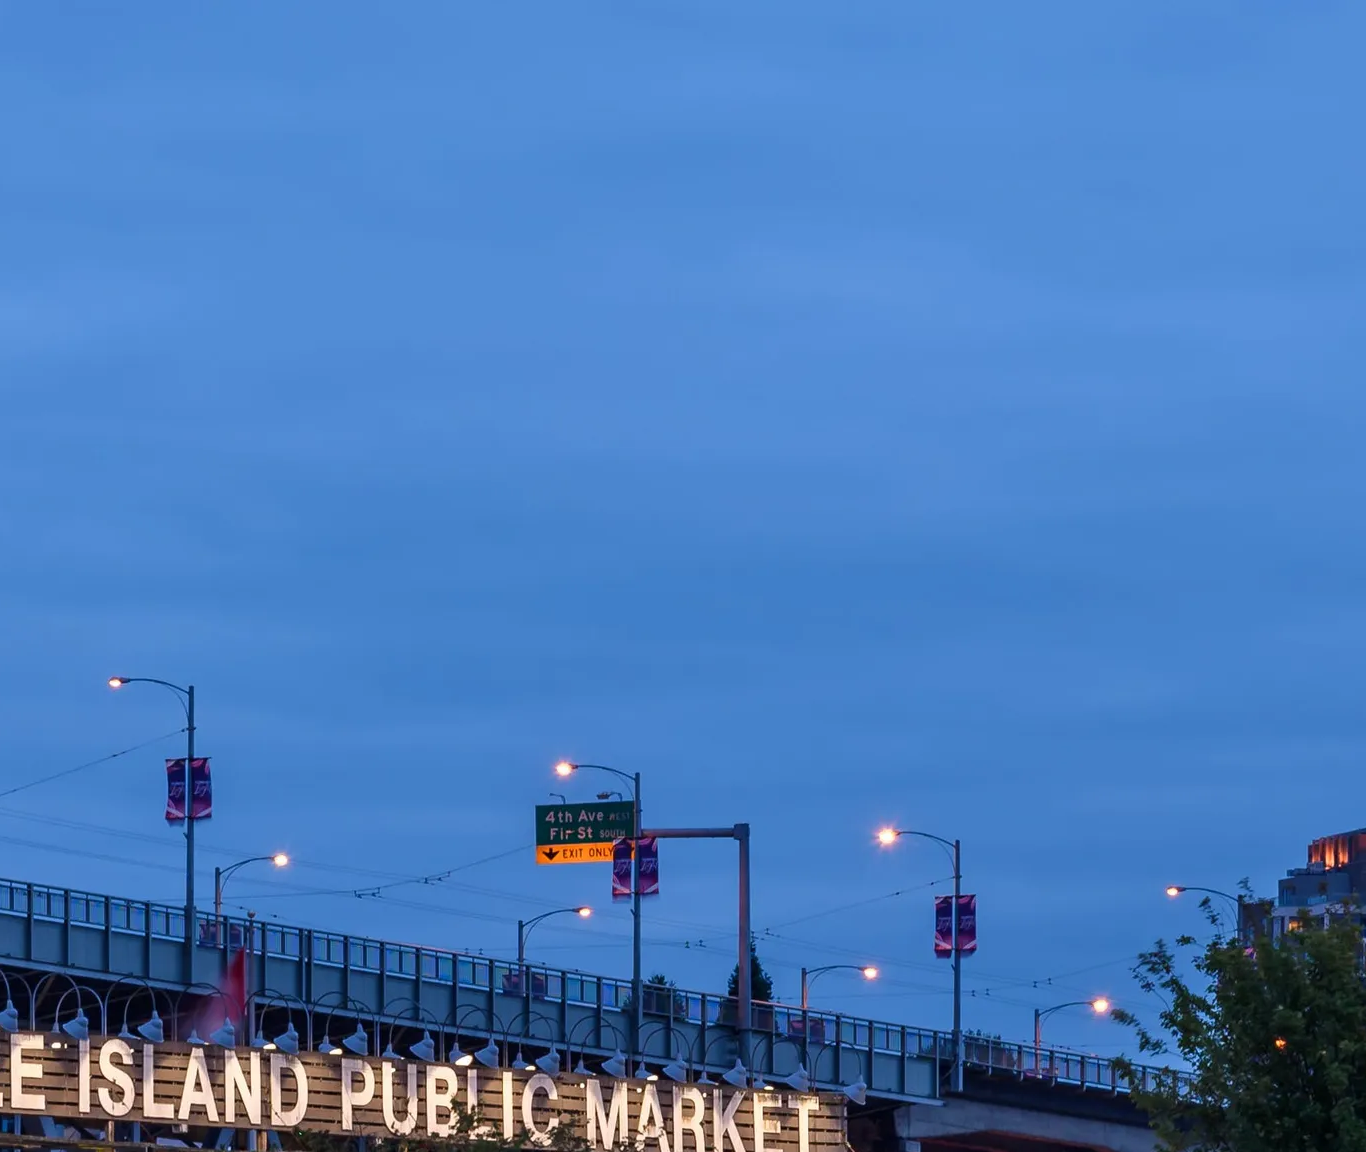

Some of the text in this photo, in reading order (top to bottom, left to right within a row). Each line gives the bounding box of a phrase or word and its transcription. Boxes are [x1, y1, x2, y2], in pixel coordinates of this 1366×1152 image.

[545, 810, 573, 824] 4th
[578, 809, 604, 822] Ave
[550, 827, 574, 840] Fir
[577, 826, 593, 839] St
[562, 848, 614, 858] EXIT ONLY
[78, 1038, 309, 1128] ISLAND
[340, 1057, 560, 1148] PUBLIC
